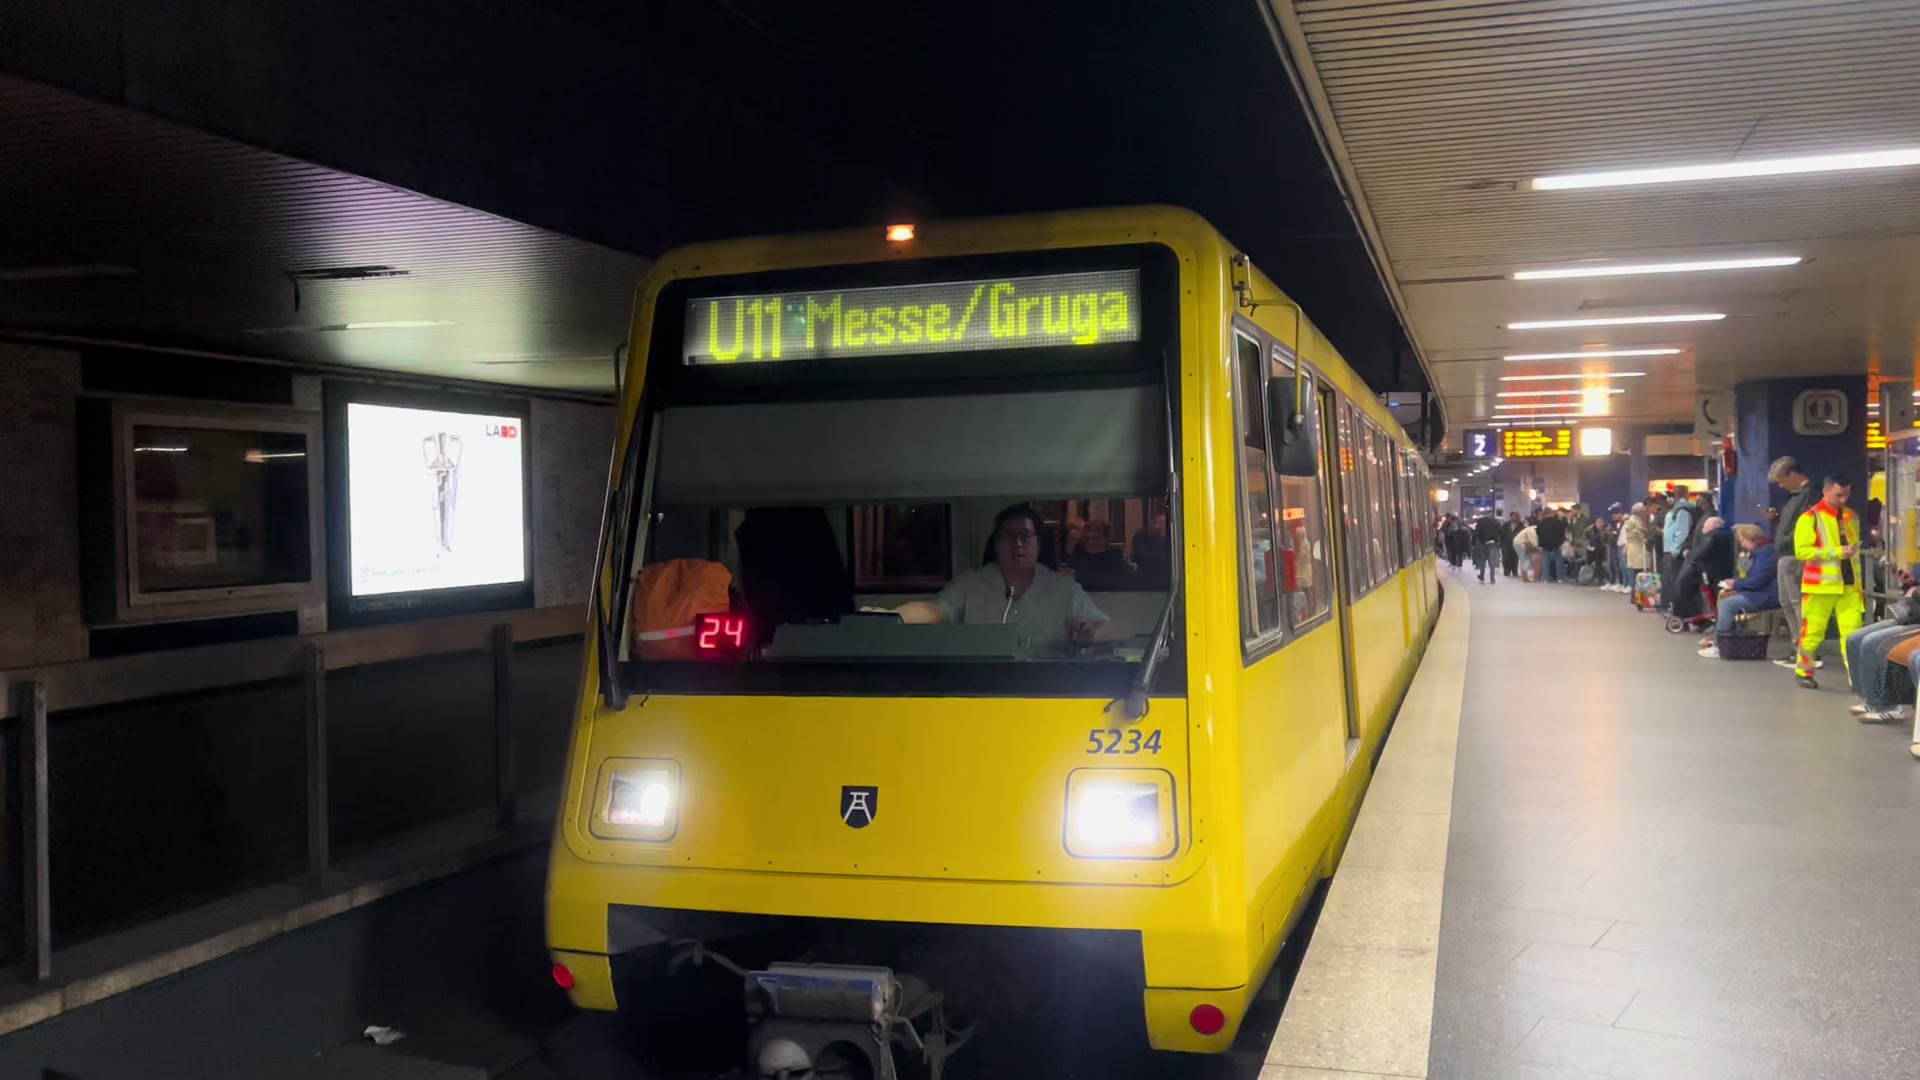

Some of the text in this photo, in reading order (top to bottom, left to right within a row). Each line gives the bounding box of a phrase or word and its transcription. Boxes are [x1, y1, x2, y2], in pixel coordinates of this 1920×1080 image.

[708, 282, 1129, 361] U11 Messe/Gruga
[1474, 439, 1486, 456] 2
[699, 617, 744, 649] 24
[1086, 729, 1162, 755] 5234
